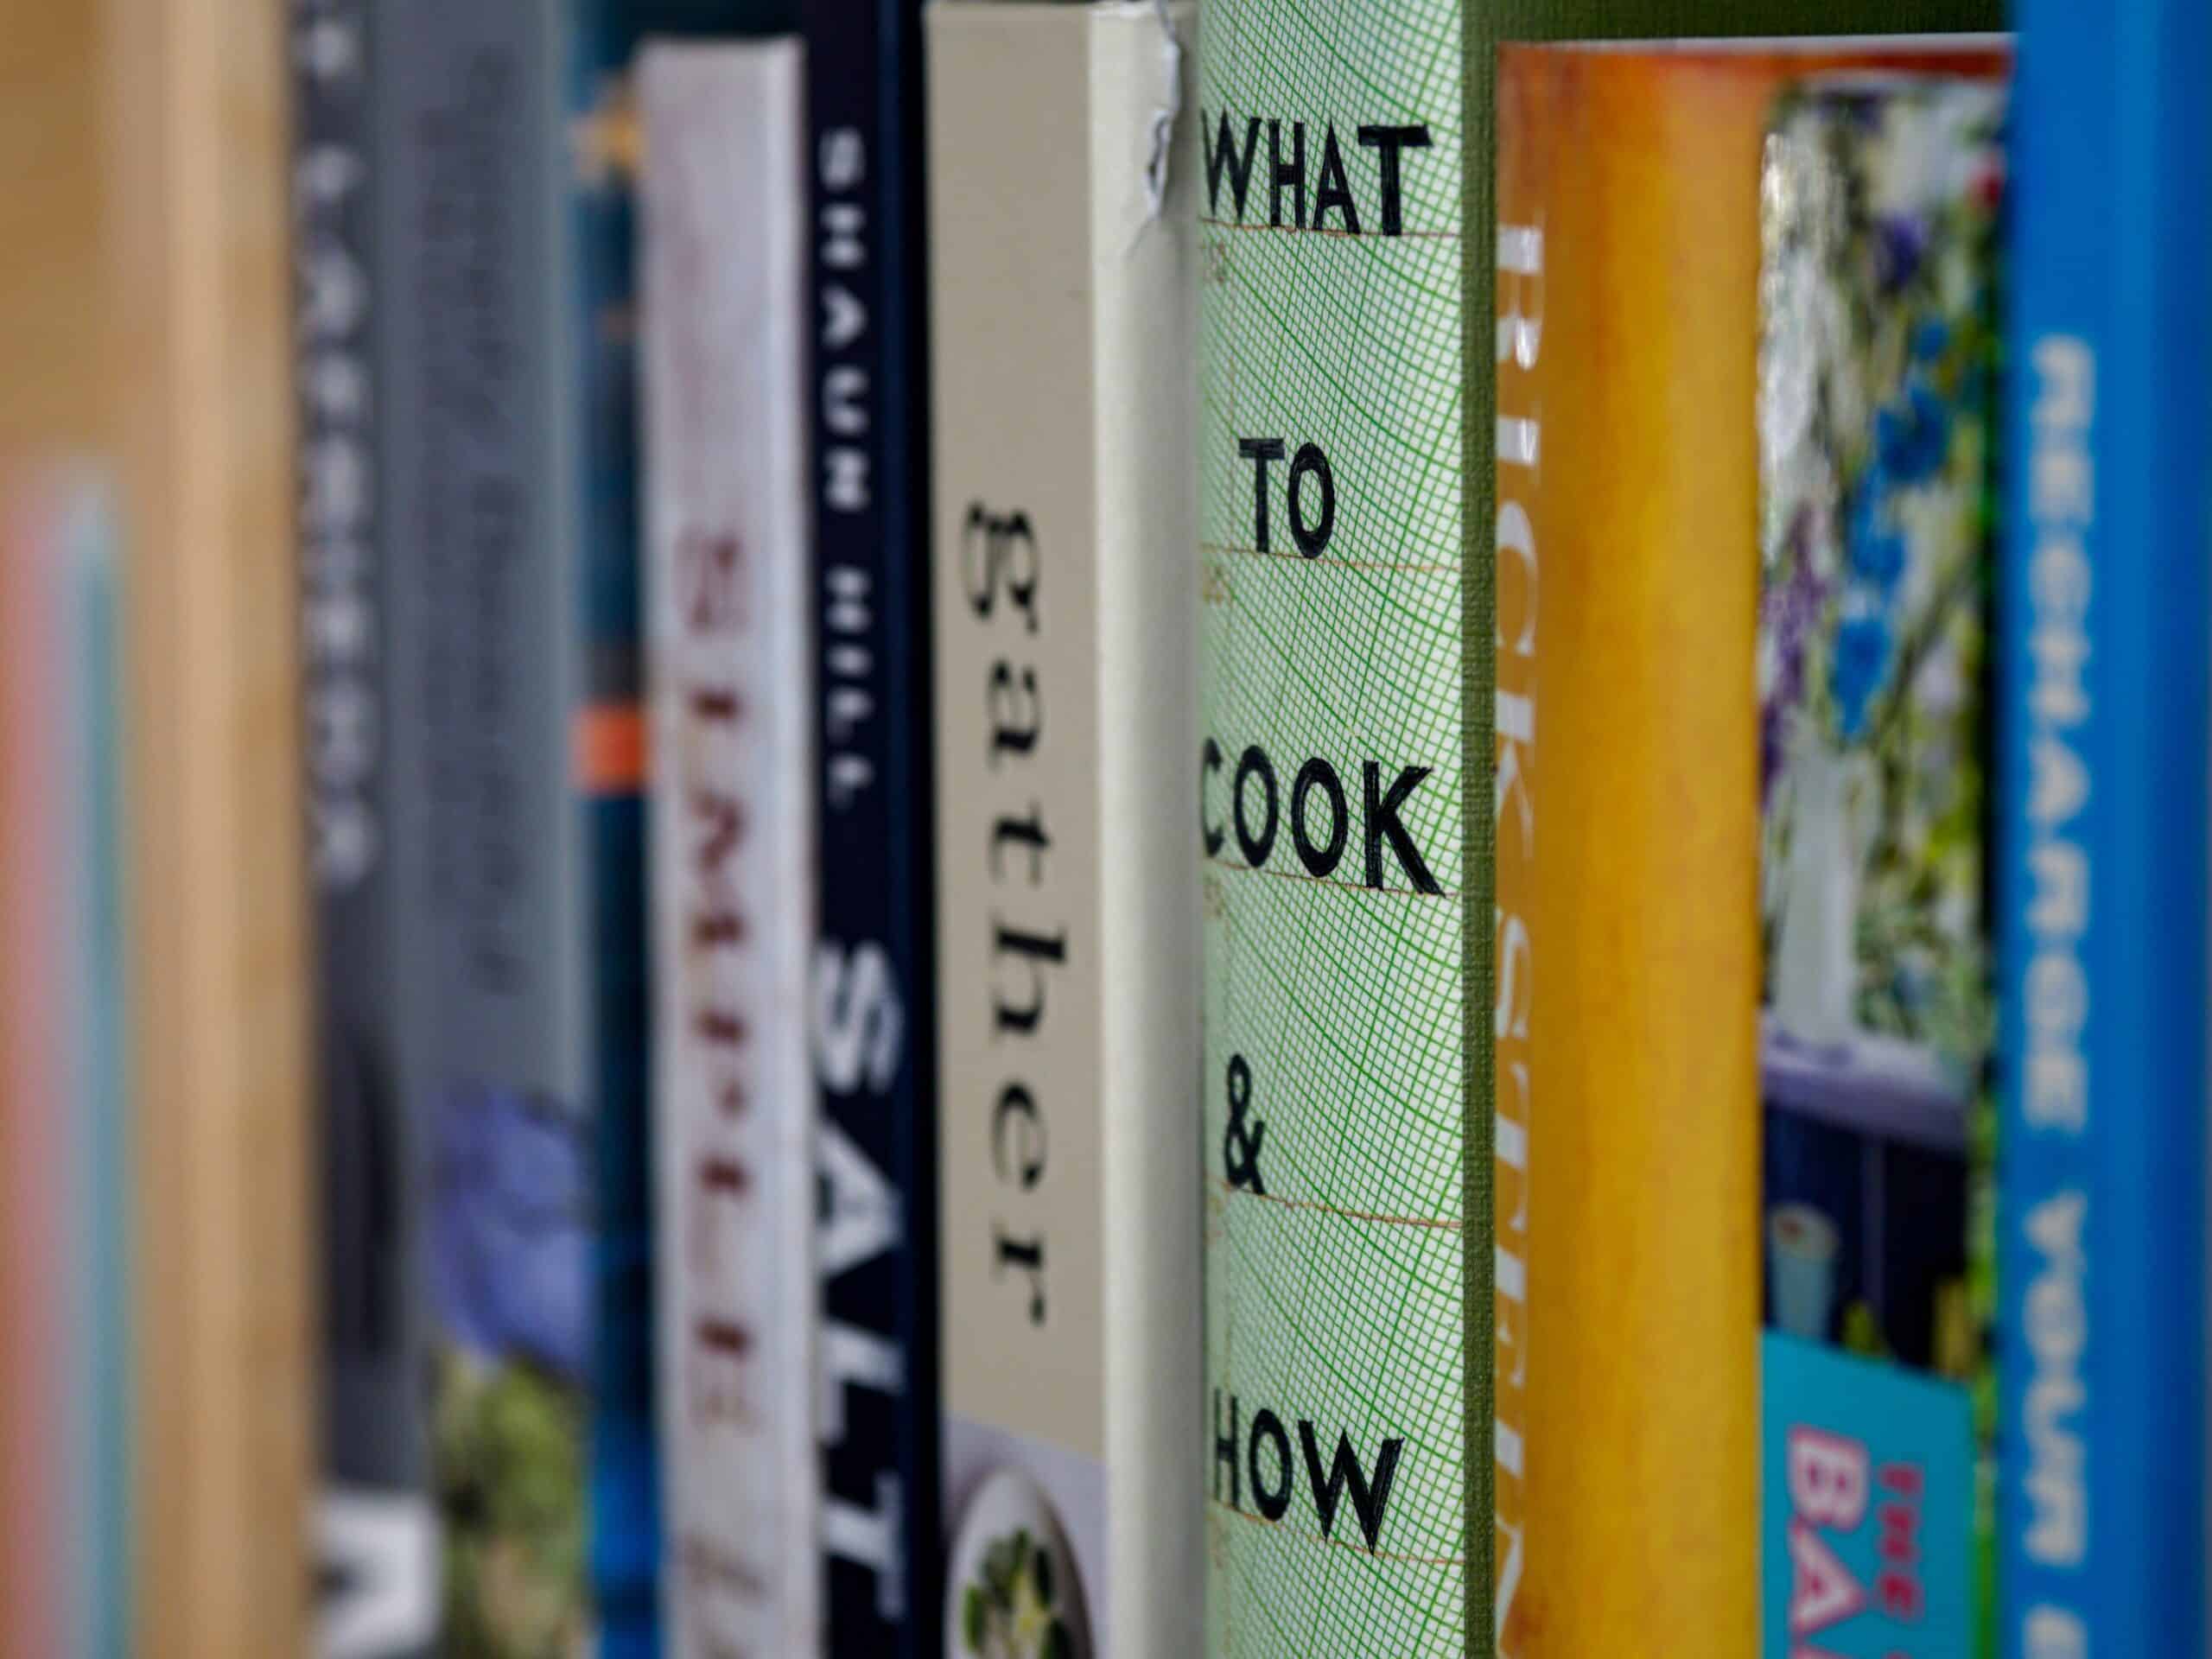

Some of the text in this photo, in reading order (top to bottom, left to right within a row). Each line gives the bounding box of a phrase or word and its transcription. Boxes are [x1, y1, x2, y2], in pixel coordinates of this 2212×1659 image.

[1201, 105, 1434, 237] WHAT
[818, 126, 874, 812] SHAUN HILL
[1237, 437, 1336, 559] TO
[1495, 206, 1545, 864] RICK
[1201, 736, 1447, 898] COOK
[2022, 332, 2096, 1134] RECHARGE
[679, 527, 762, 1427] SIMPLE
[961, 499, 1070, 1329] gather
[814, 933, 907, 1623] SALT
[1224, 1053, 1265, 1196] &
[1213, 1387, 1407, 1556] HOW
[2020, 1185, 2089, 1567] YOUR
[1787, 1422, 1873, 1659] BA
[1873, 1460, 1927, 1623] THE
